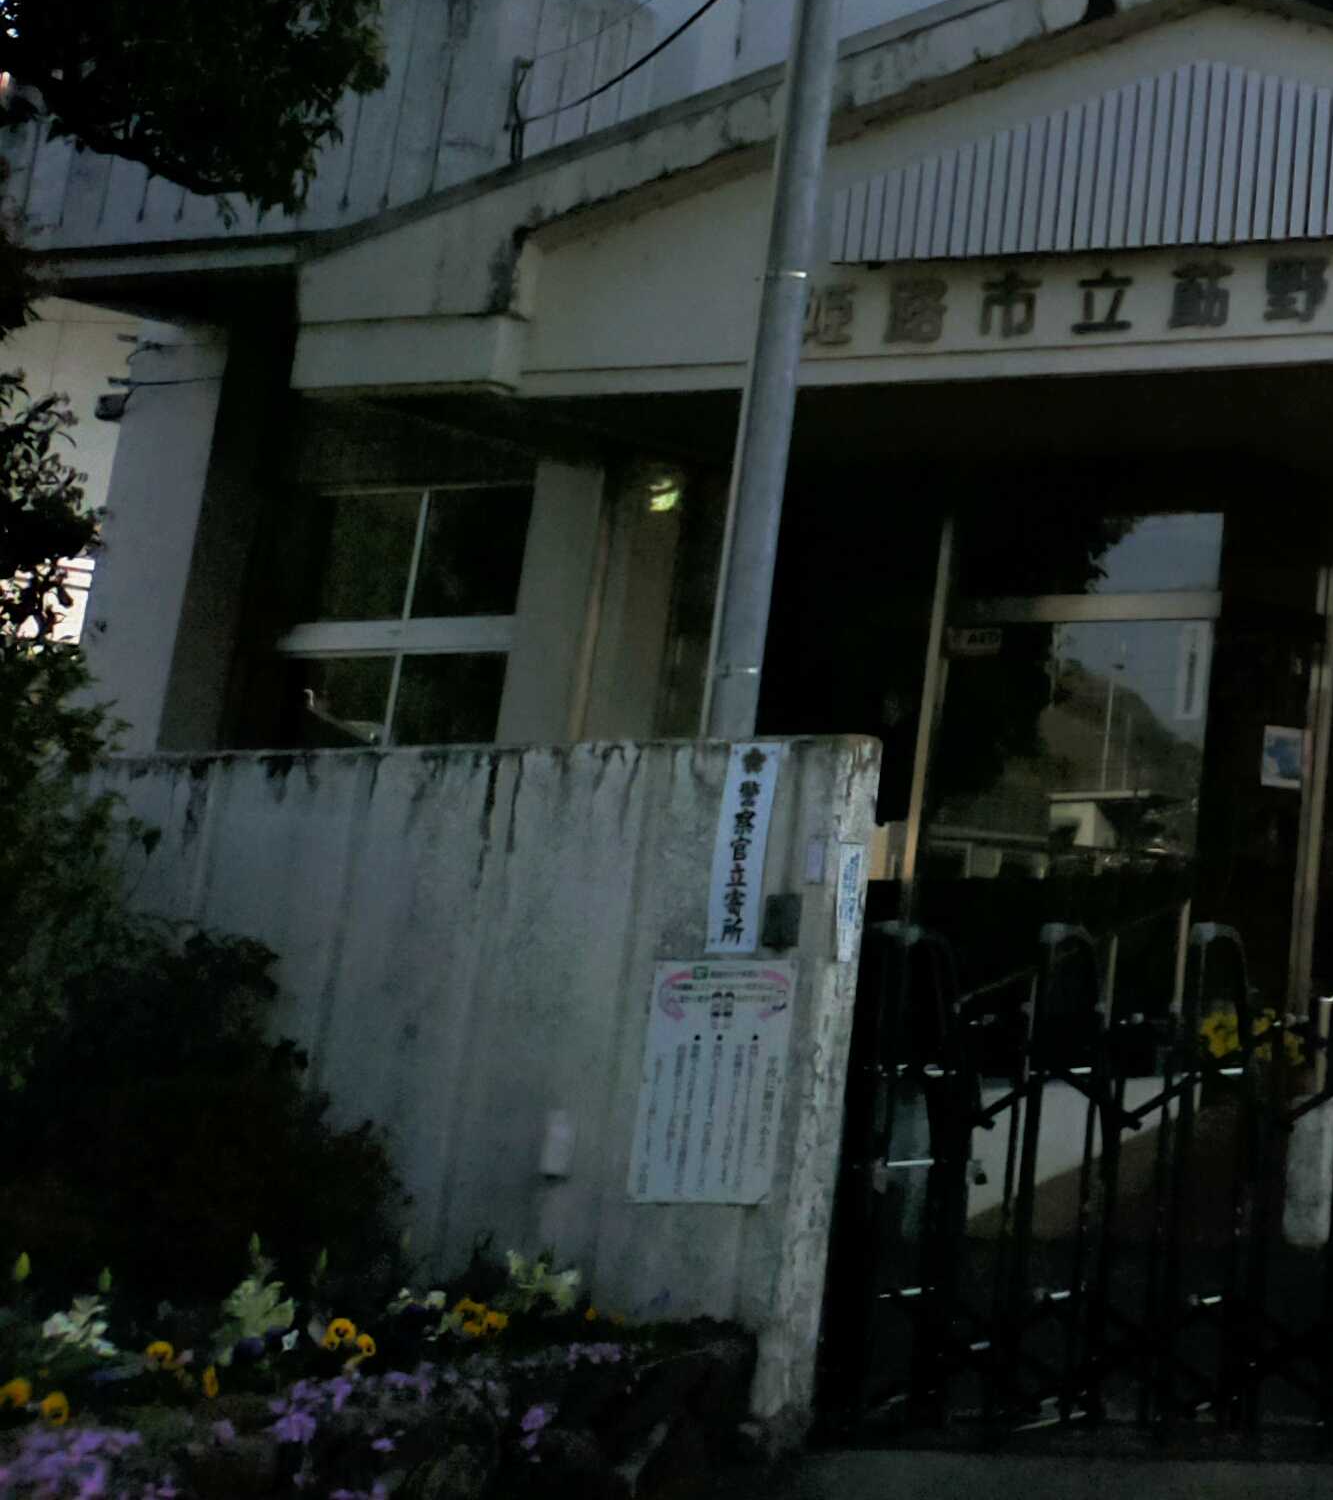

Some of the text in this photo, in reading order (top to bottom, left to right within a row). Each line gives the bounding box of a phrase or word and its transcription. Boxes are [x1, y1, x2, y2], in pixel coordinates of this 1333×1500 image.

[720, 780, 762, 945] 警察官立寄所
